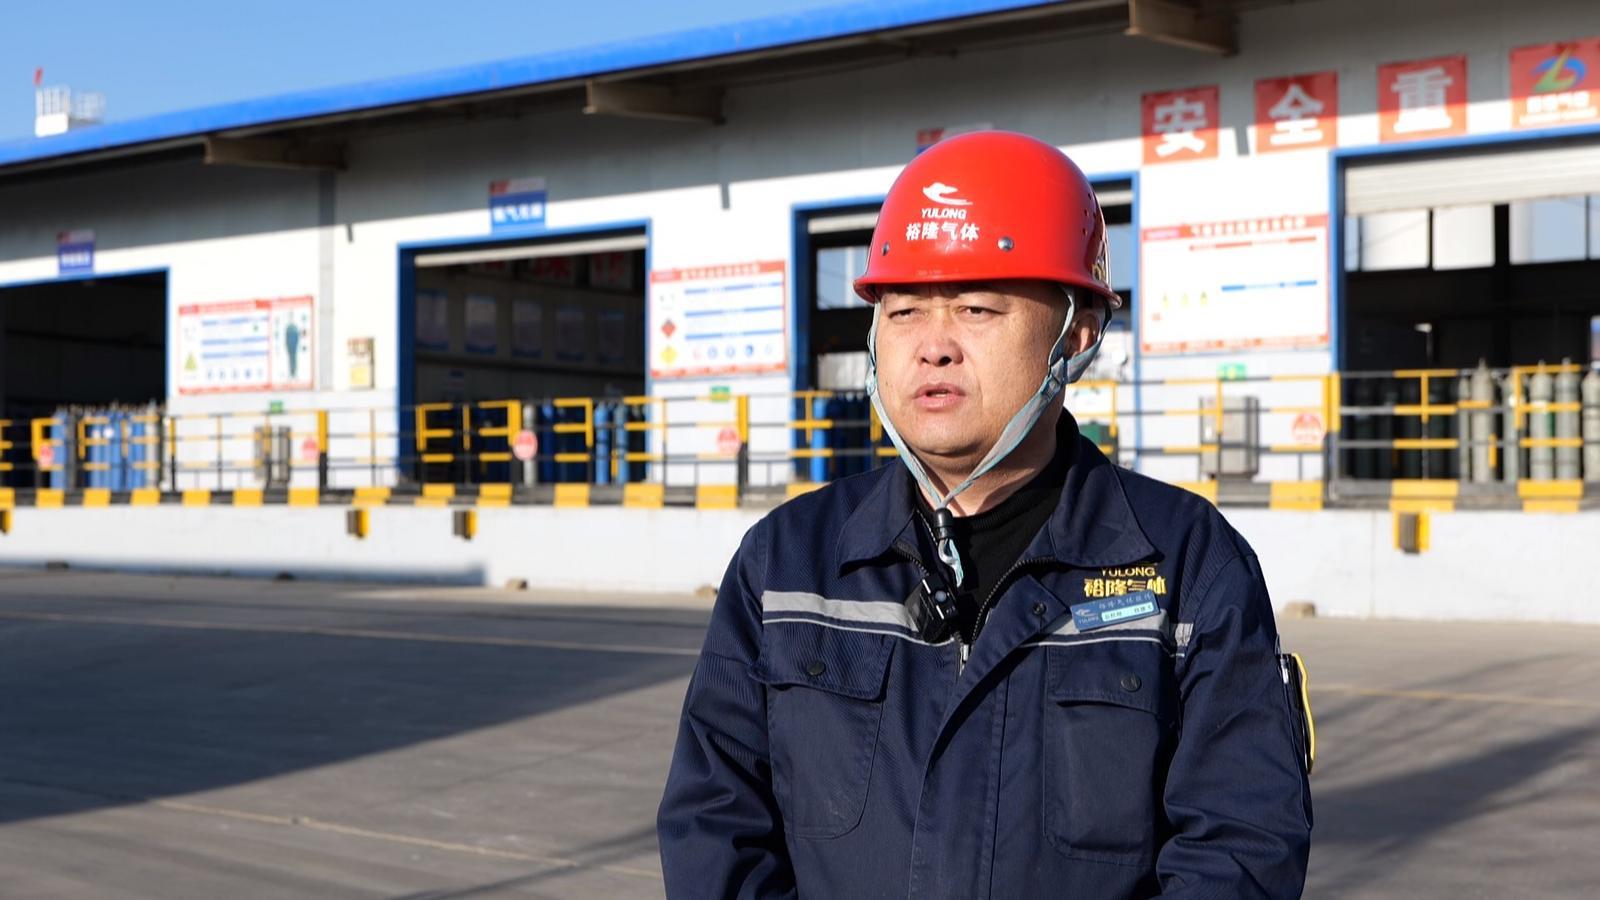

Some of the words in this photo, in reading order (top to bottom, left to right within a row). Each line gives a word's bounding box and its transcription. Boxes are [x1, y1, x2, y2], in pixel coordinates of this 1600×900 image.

[1153, 98, 1208, 156] 安
[1268, 83, 1325, 146] 全
[1391, 67, 1454, 133] 重
[921, 208, 967, 219] YULONG
[906, 221, 980, 241] 裕隆气体
